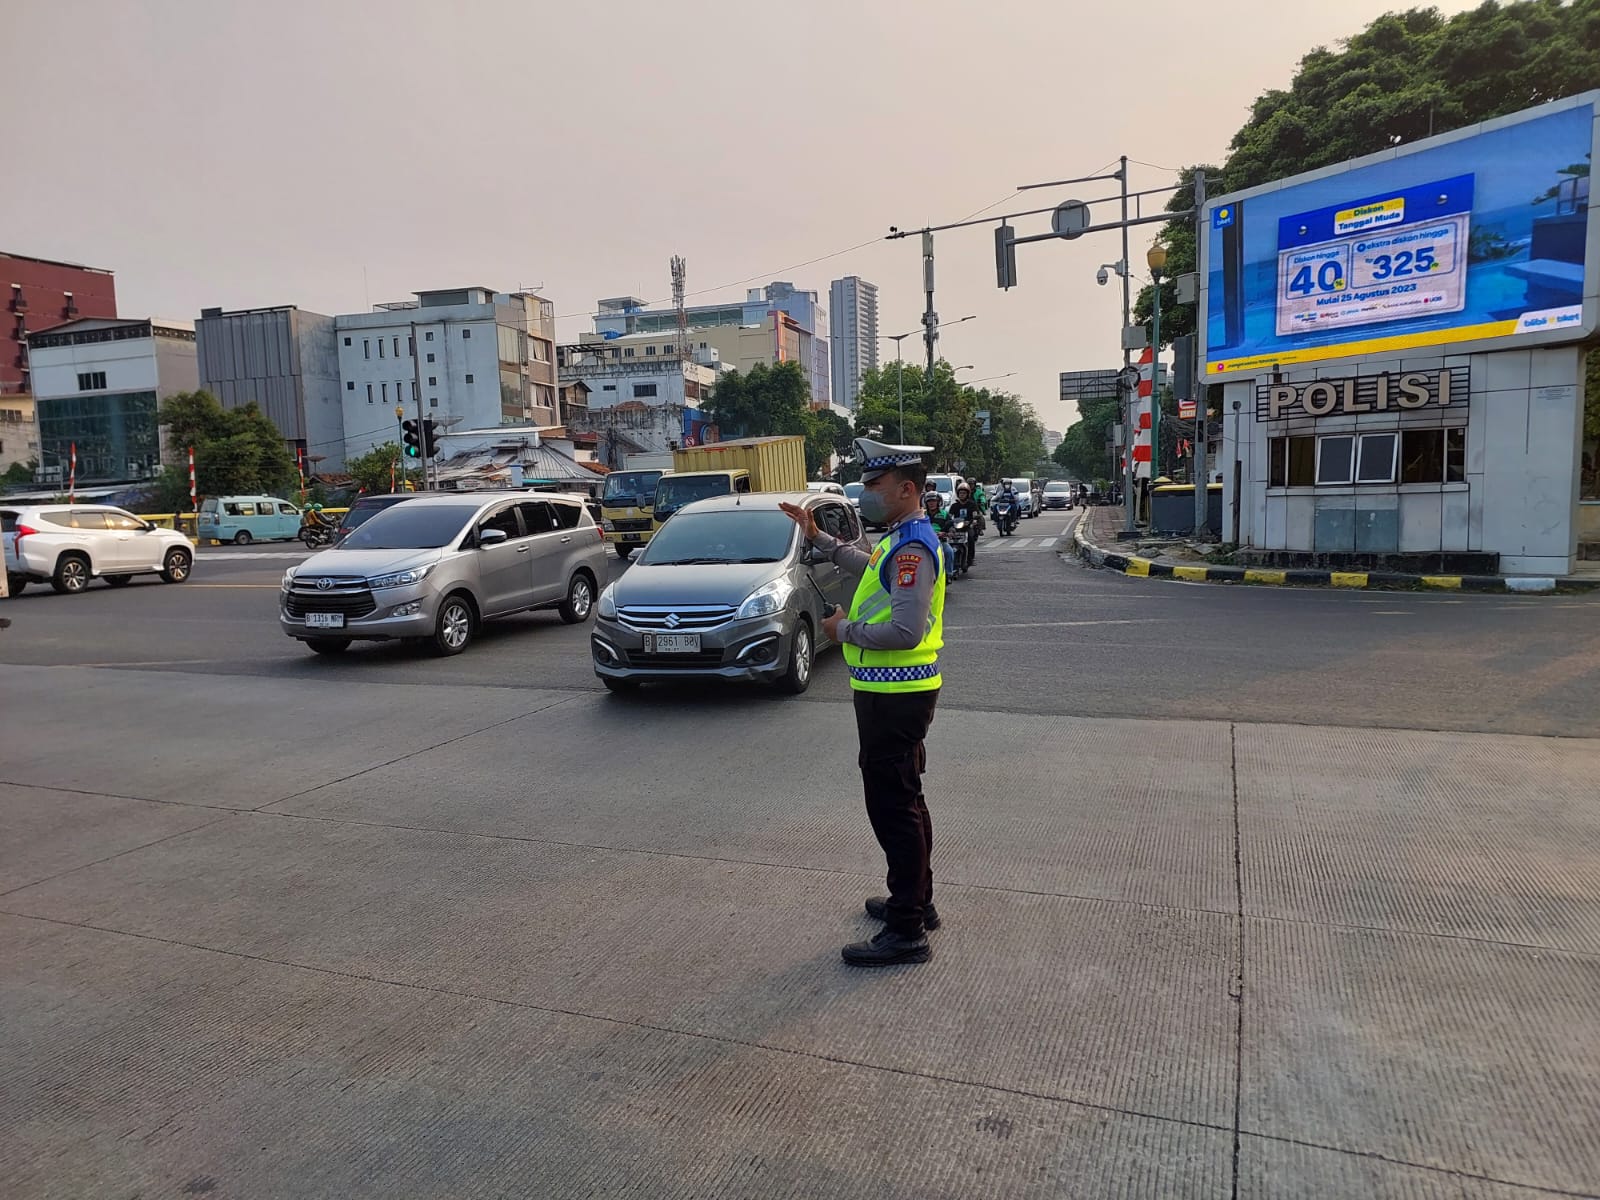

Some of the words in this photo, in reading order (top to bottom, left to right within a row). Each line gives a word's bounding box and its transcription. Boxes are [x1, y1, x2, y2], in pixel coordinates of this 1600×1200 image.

[1353, 204, 1384, 217] Diskon
[1338, 217, 1373, 231] Tanggal
[1374, 211, 1400, 223] Muda
[1365, 240, 1390, 251] ekstra
[1391, 234, 1419, 247] diskon
[1419, 228, 1449, 240] hingga
[1294, 253, 1315, 264] Diskon
[1315, 250, 1340, 261] hingga
[1316, 294, 1340, 306] Mulai
[1341, 293, 1353, 302] 25
[1353, 289, 1390, 302] Agustus
[1391, 283, 1417, 295] 2023
[1268, 369, 1451, 419] POLISI
[645, 635, 651, 647] B
